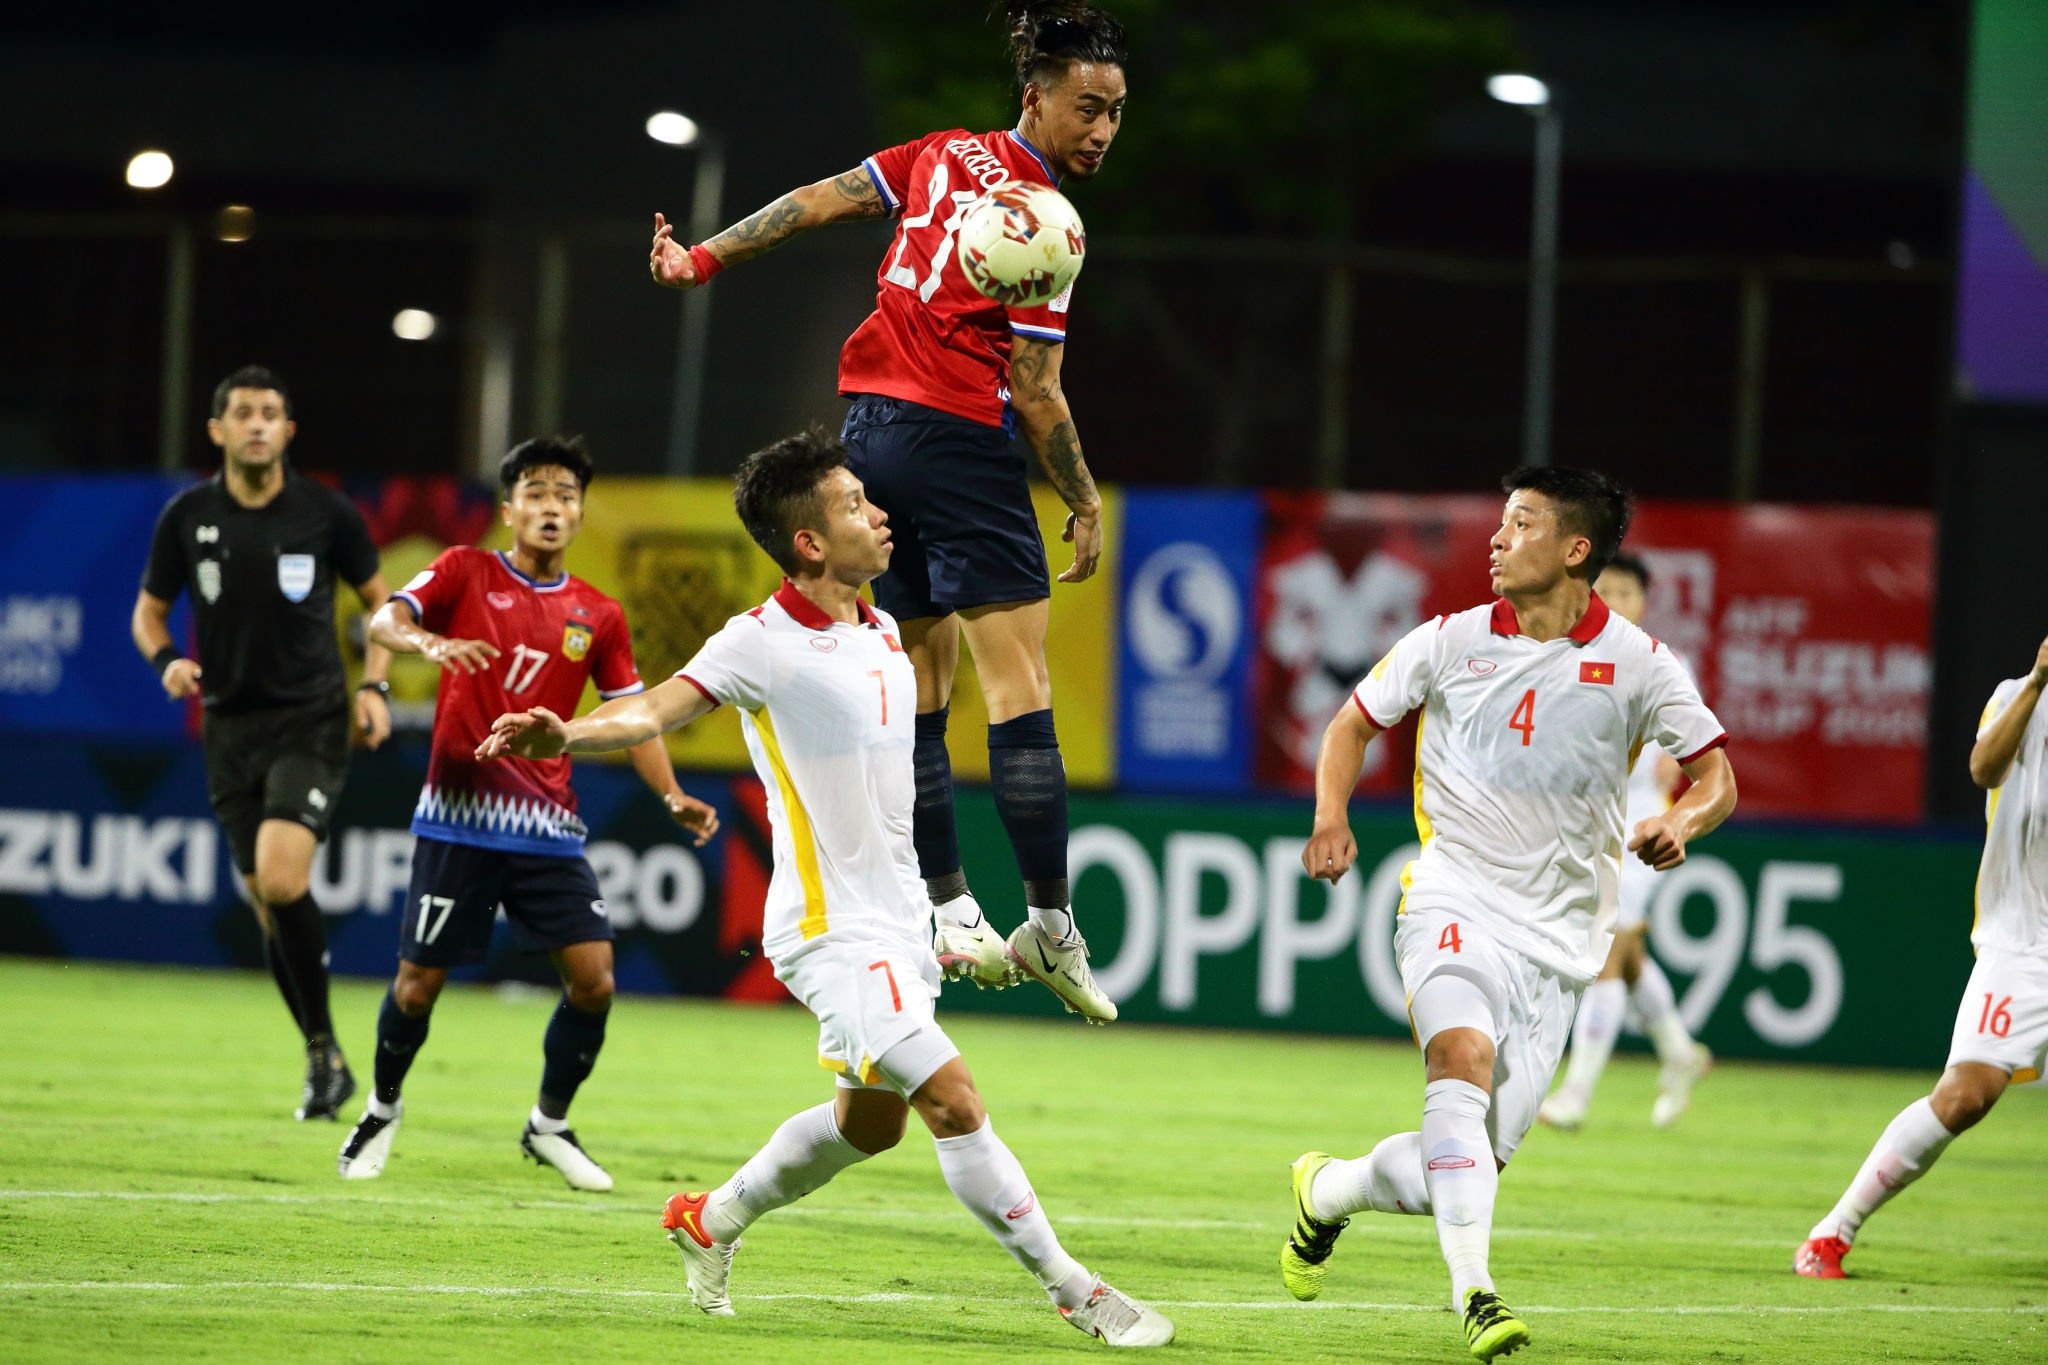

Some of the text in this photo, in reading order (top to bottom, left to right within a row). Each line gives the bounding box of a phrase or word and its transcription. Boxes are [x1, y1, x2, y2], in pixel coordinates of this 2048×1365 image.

[503, 643, 549, 695] 17
[867, 669, 888, 726] 7
[1508, 687, 1536, 747] 4
[231, 820, 414, 917] UP
[414, 893, 455, 946] 17
[1437, 922, 1464, 954] 4
[1622, 852, 1846, 1048] 95
[868, 959, 903, 1013] 7
[1978, 992, 2013, 1039] 16
